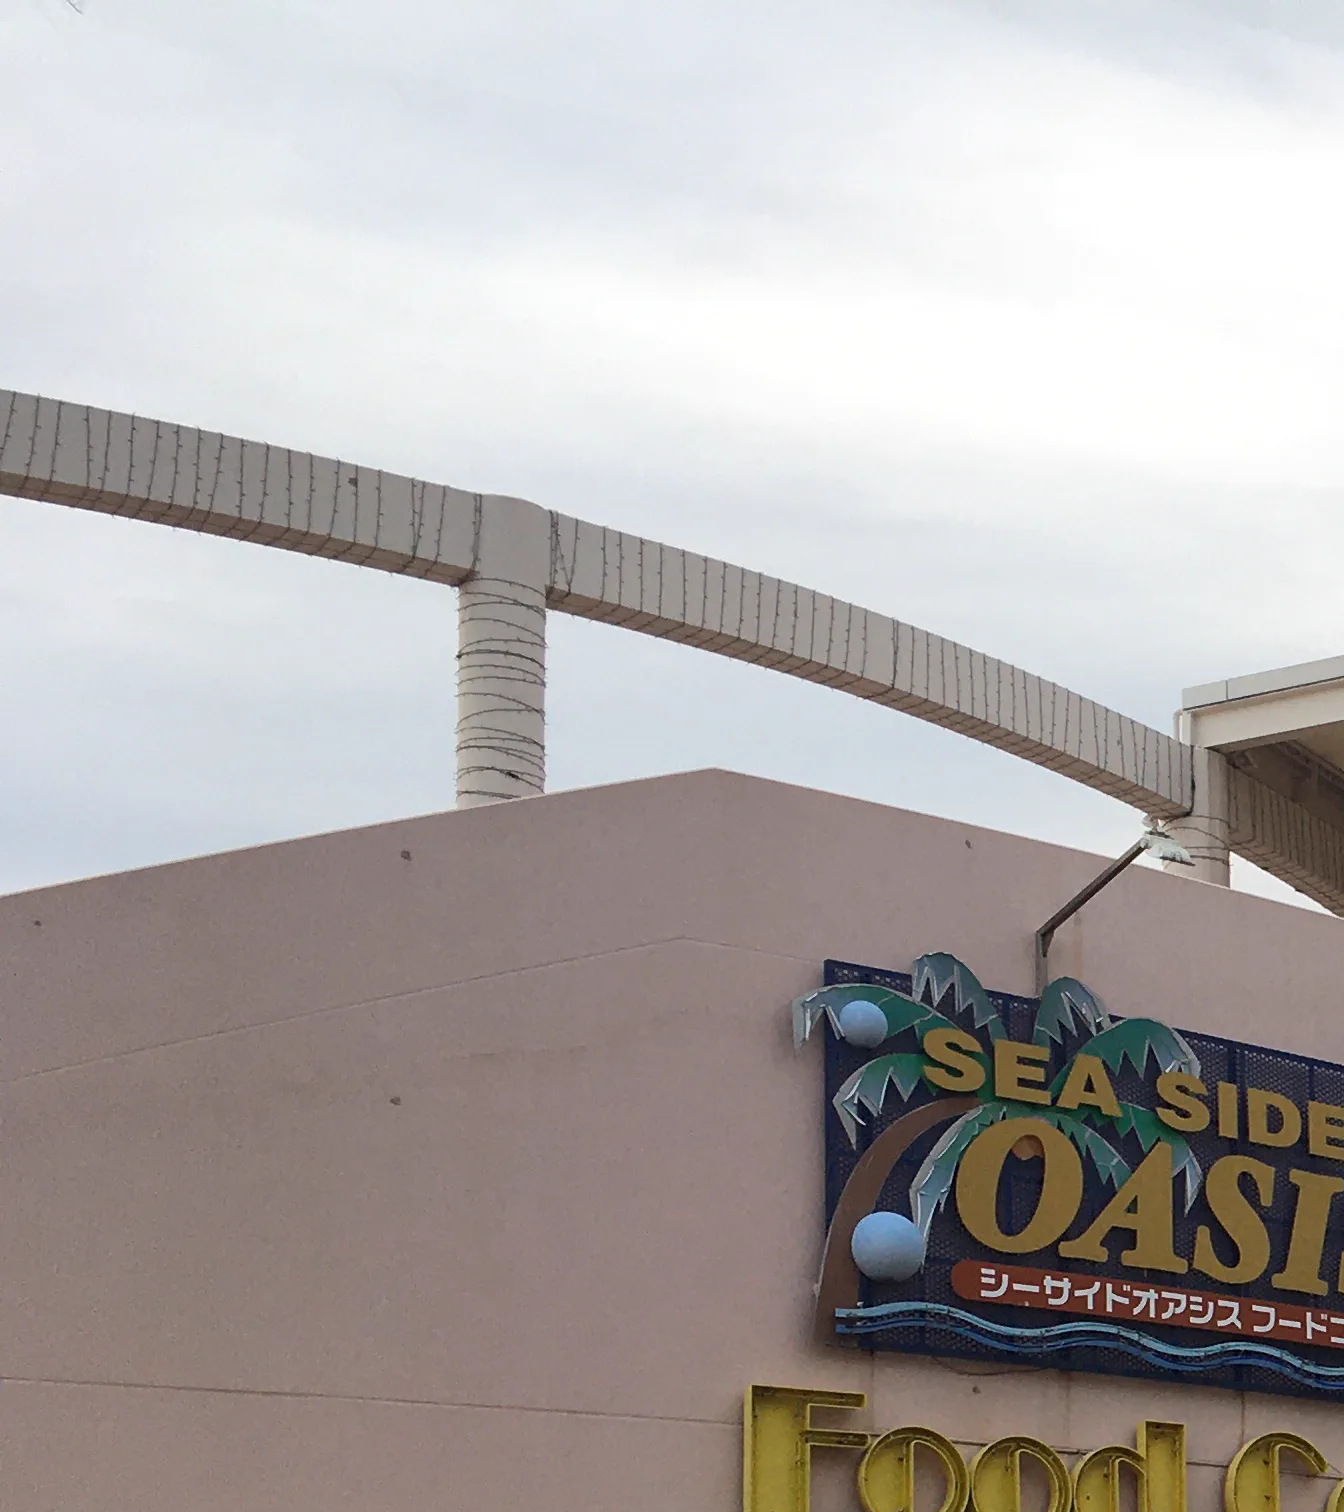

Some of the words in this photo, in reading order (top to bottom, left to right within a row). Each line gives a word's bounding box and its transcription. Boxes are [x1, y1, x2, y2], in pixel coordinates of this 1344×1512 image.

[923, 1028, 1123, 1118] SEA
[980, 1267, 1243, 1330] シーサイドオアシス
